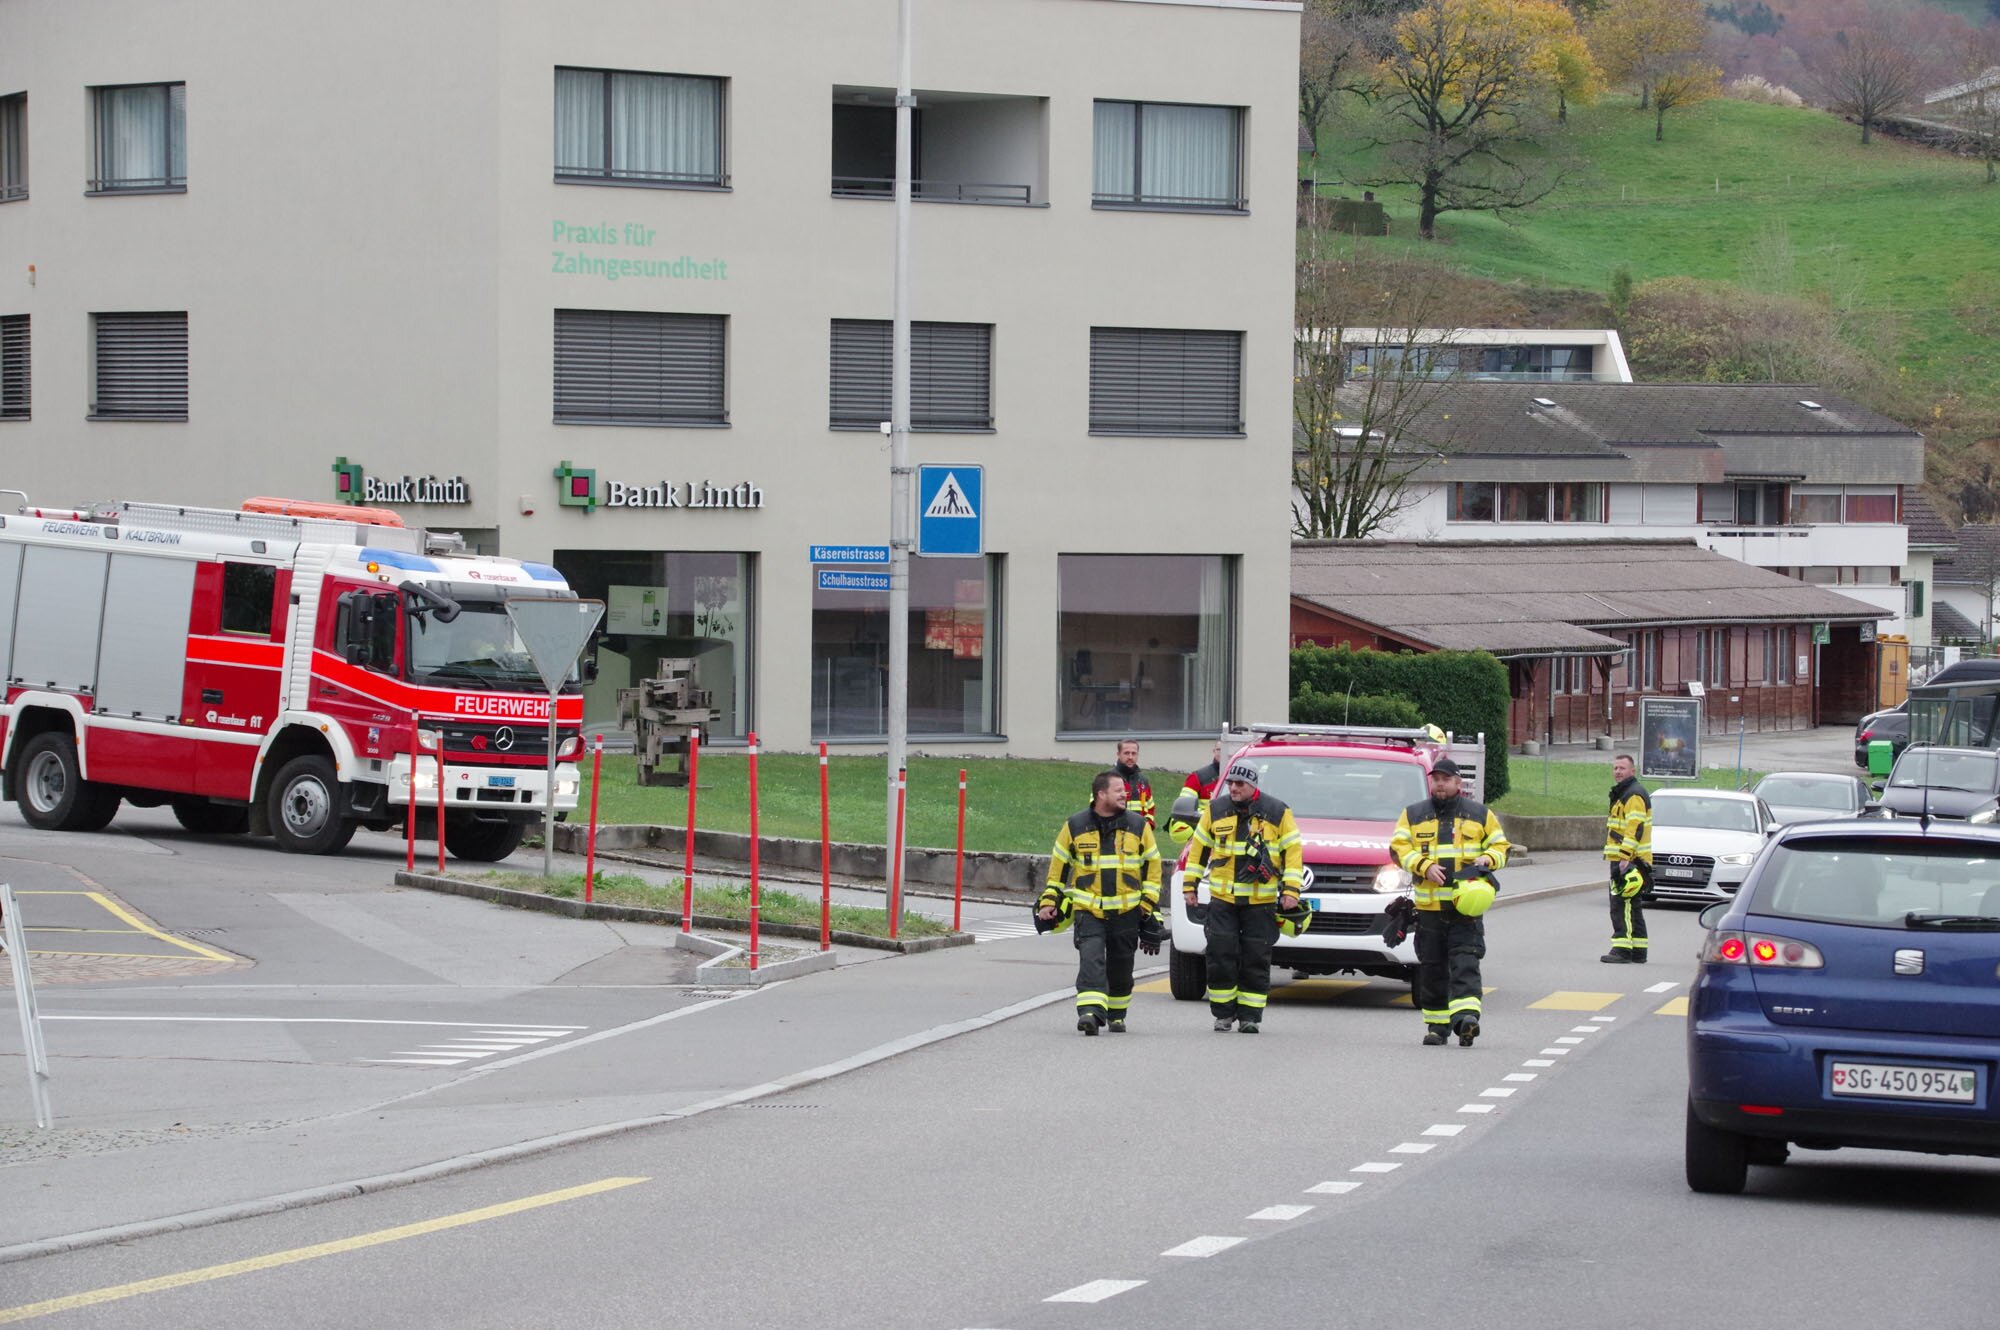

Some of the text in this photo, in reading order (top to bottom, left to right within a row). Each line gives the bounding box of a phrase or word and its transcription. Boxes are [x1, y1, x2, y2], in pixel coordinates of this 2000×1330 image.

[552, 220, 657, 247] Praxis für
[552, 251, 728, 281] Zahngesundheit
[364, 474, 468, 504] Bank Linth
[606, 479, 765, 508] Bank Linth
[42, 521, 182, 545] FEUERWEHR KALTBRUNN
[814, 547, 886, 560] Käsereistrasse
[822, 572, 888, 588] Schulhausstrasse
